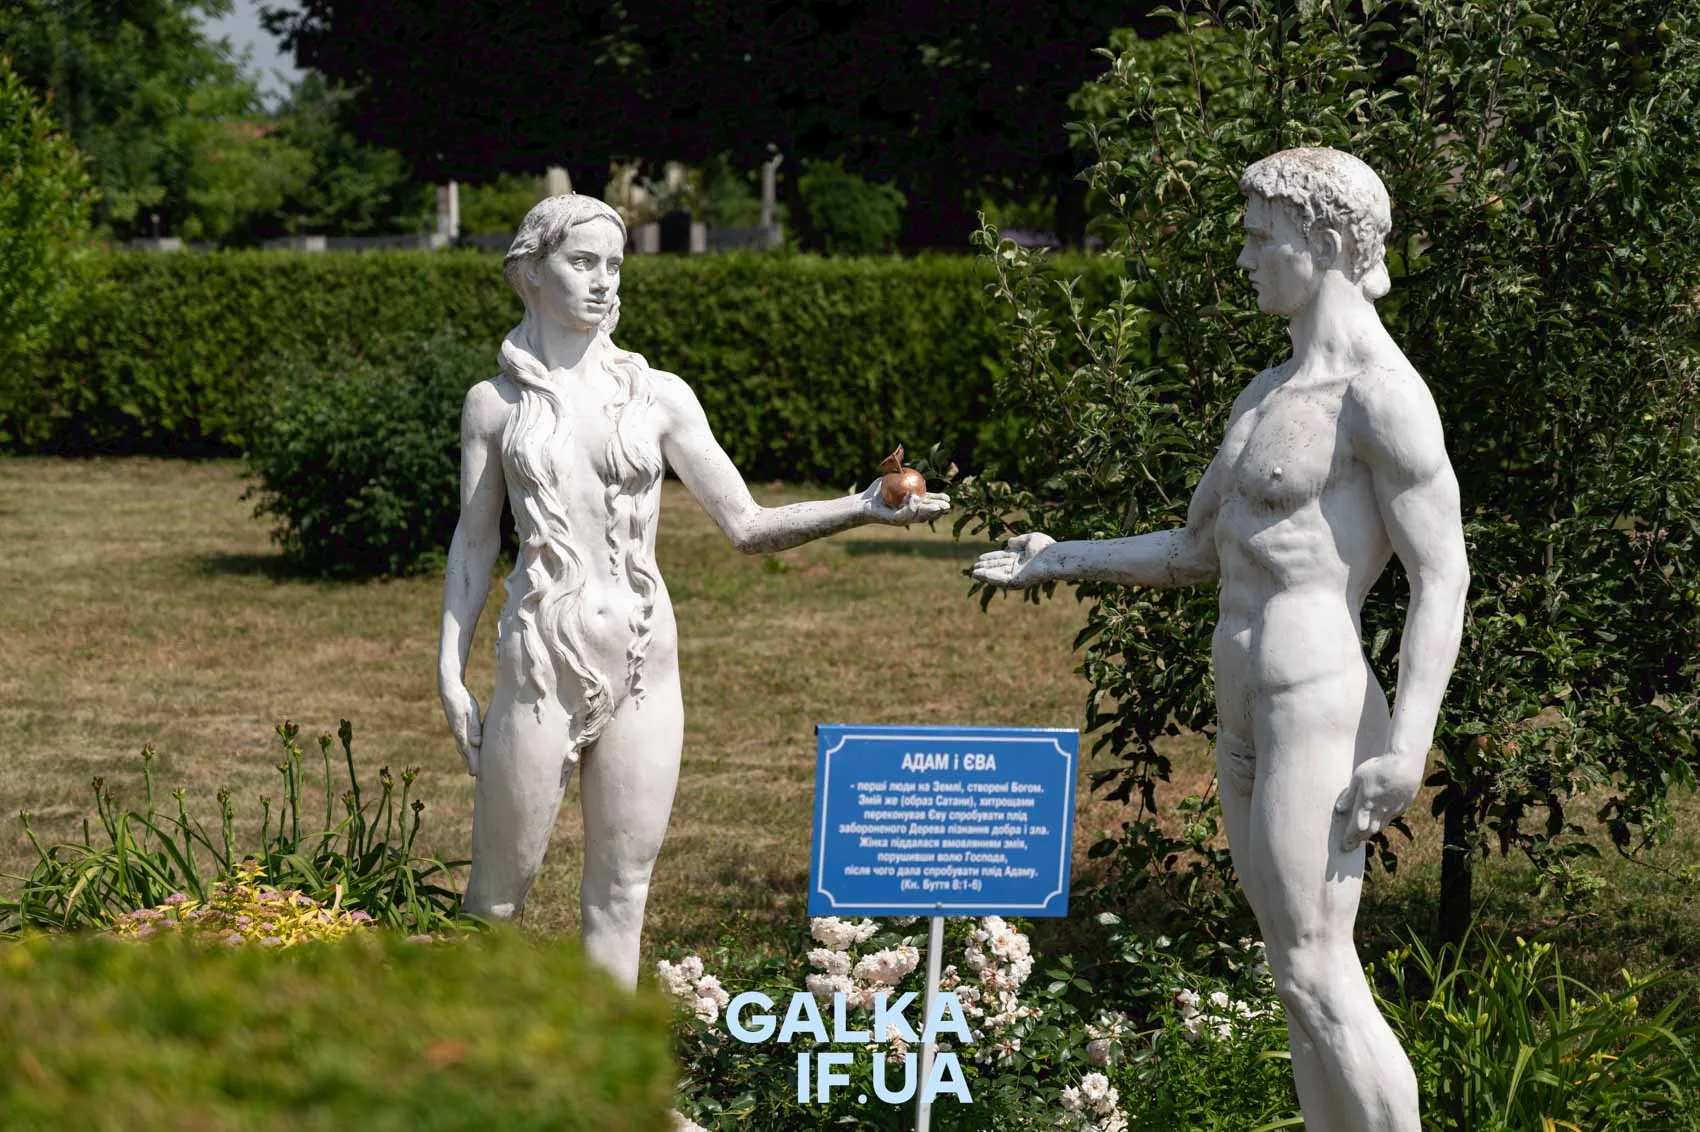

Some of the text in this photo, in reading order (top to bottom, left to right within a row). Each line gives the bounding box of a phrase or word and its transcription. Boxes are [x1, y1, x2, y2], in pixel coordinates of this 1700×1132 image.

[901, 752, 949, 773] АДАМ
[963, 753, 996, 771] ЄВА
[857, 781, 887, 793] перші
[889, 782, 916, 792] люди
[918, 783, 930, 792] на
[932, 781, 964, 794] Землі,
[967, 782, 1009, 794] створені
[1011, 781, 1044, 793] Богом.
[858, 793, 1035, 809] Змій же (образ Сатани), хитрощами
[863, 808, 1028, 822] переконував Єву спробувати плід
[838, 821, 907, 835] забороненого
[908, 823, 945, 836] Дерева
[947, 823, 990, 835] пізнання
[991, 823, 1022, 836] добра
[1029, 825, 1050, 835] зла.
[859, 836, 888, 848] Жінка
[877, 851, 1008, 864] порушивши волю Господа,
[844, 865, 1039, 878] після чого дала спробувати плід Адаму.
